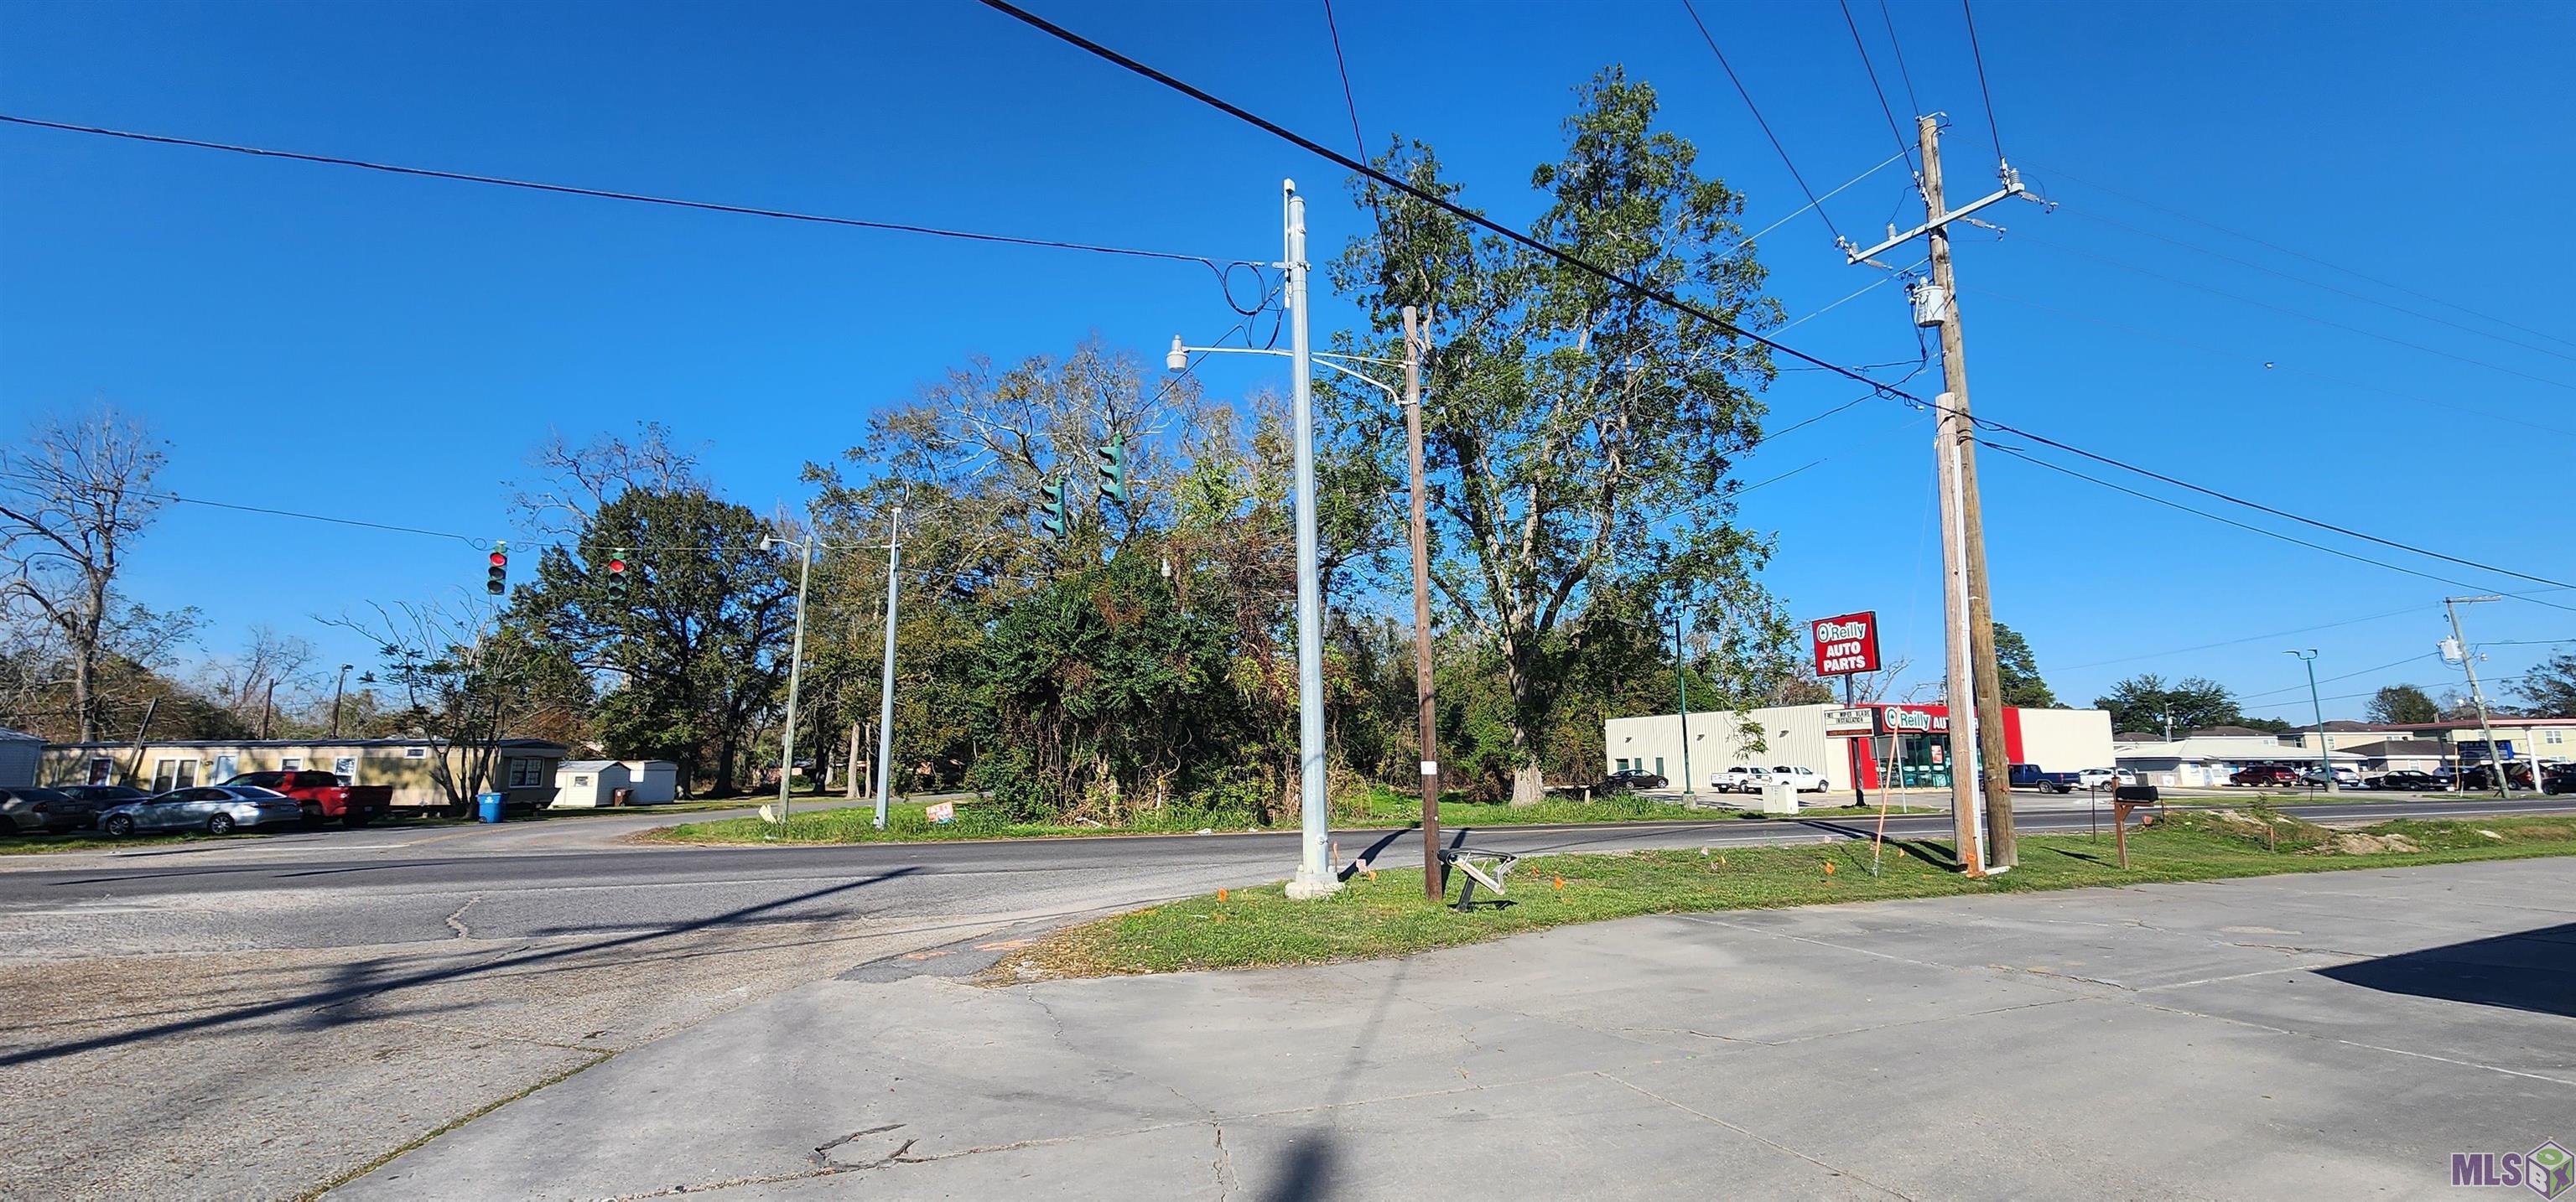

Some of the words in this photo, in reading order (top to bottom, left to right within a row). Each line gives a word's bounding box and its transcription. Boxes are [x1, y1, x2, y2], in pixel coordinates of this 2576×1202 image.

[1817, 623, 1866, 643] O'Reilly
[1826, 641, 1861, 657] AUTO
[1823, 655, 1866, 672] PARTS
[1885, 707, 1930, 732] OReilly
